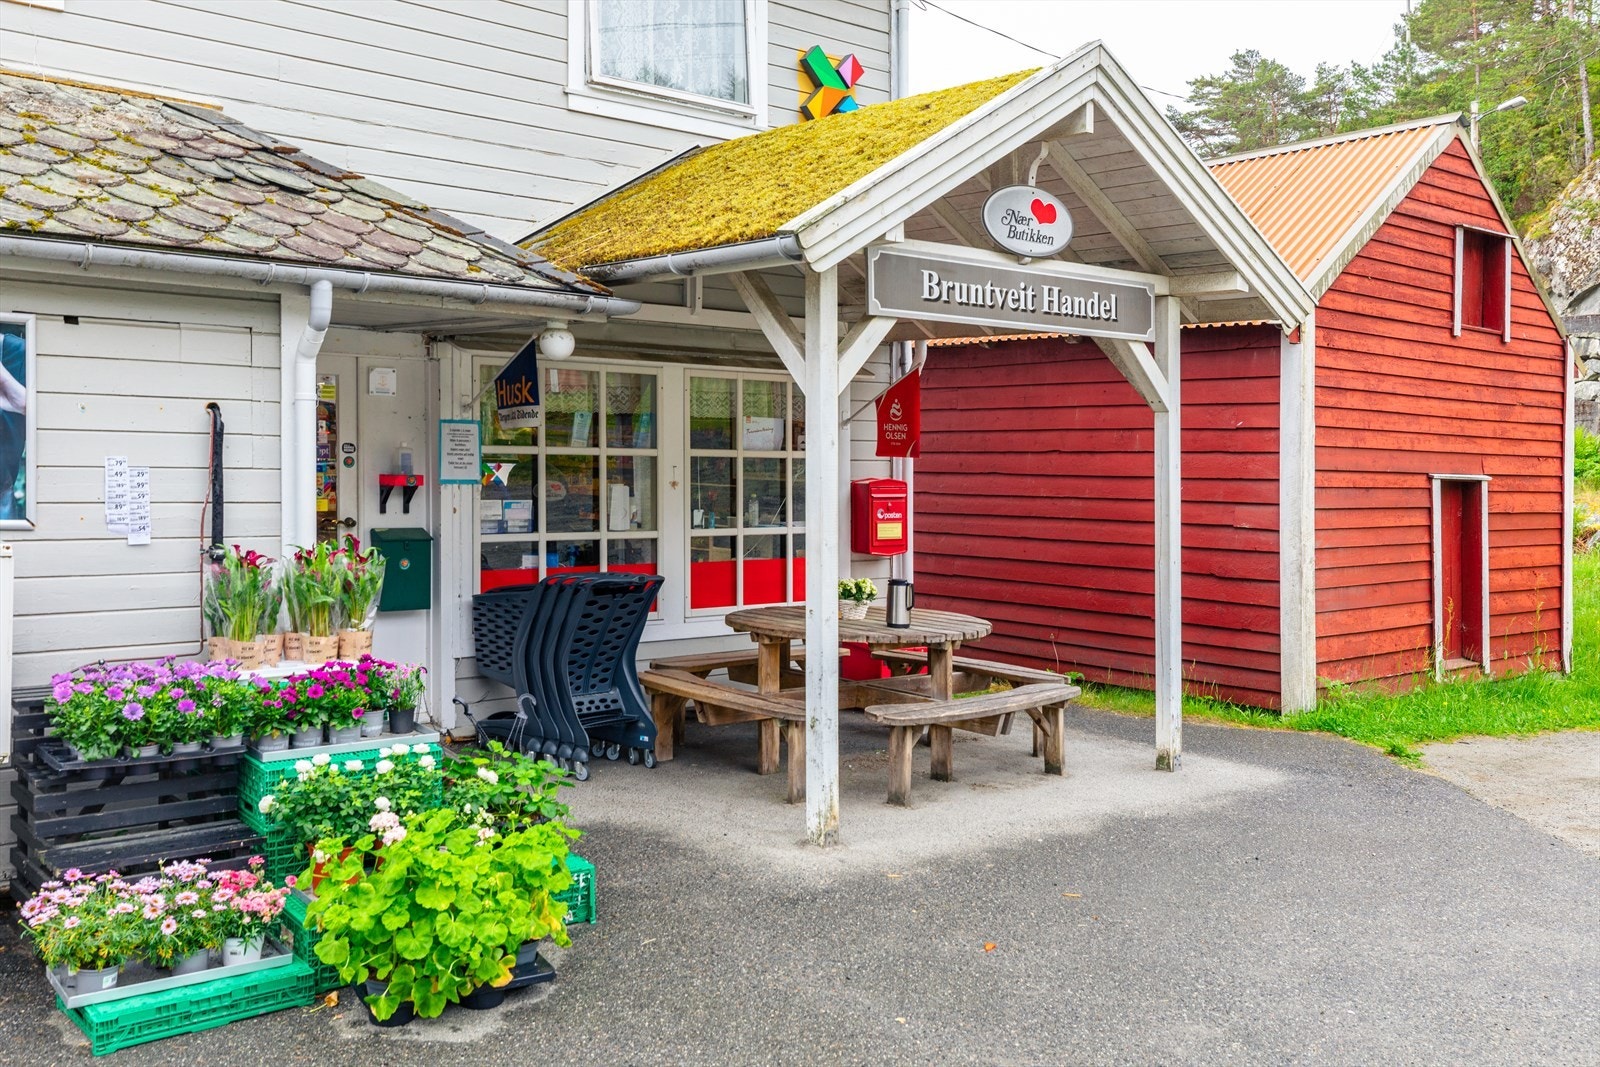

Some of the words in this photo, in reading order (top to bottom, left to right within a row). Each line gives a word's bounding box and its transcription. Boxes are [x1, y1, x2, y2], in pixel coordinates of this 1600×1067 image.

[1001, 208, 1034, 227] Nær
[1007, 224, 1055, 246] Butikken
[920, 269, 1036, 312] Bruntveit
[1041, 284, 1118, 321] Handel
[497, 374, 535, 407] Husk
[883, 423, 908, 432] HENNIG
[885, 431, 907, 440] OLSEN
[884, 512, 902, 520] posten
